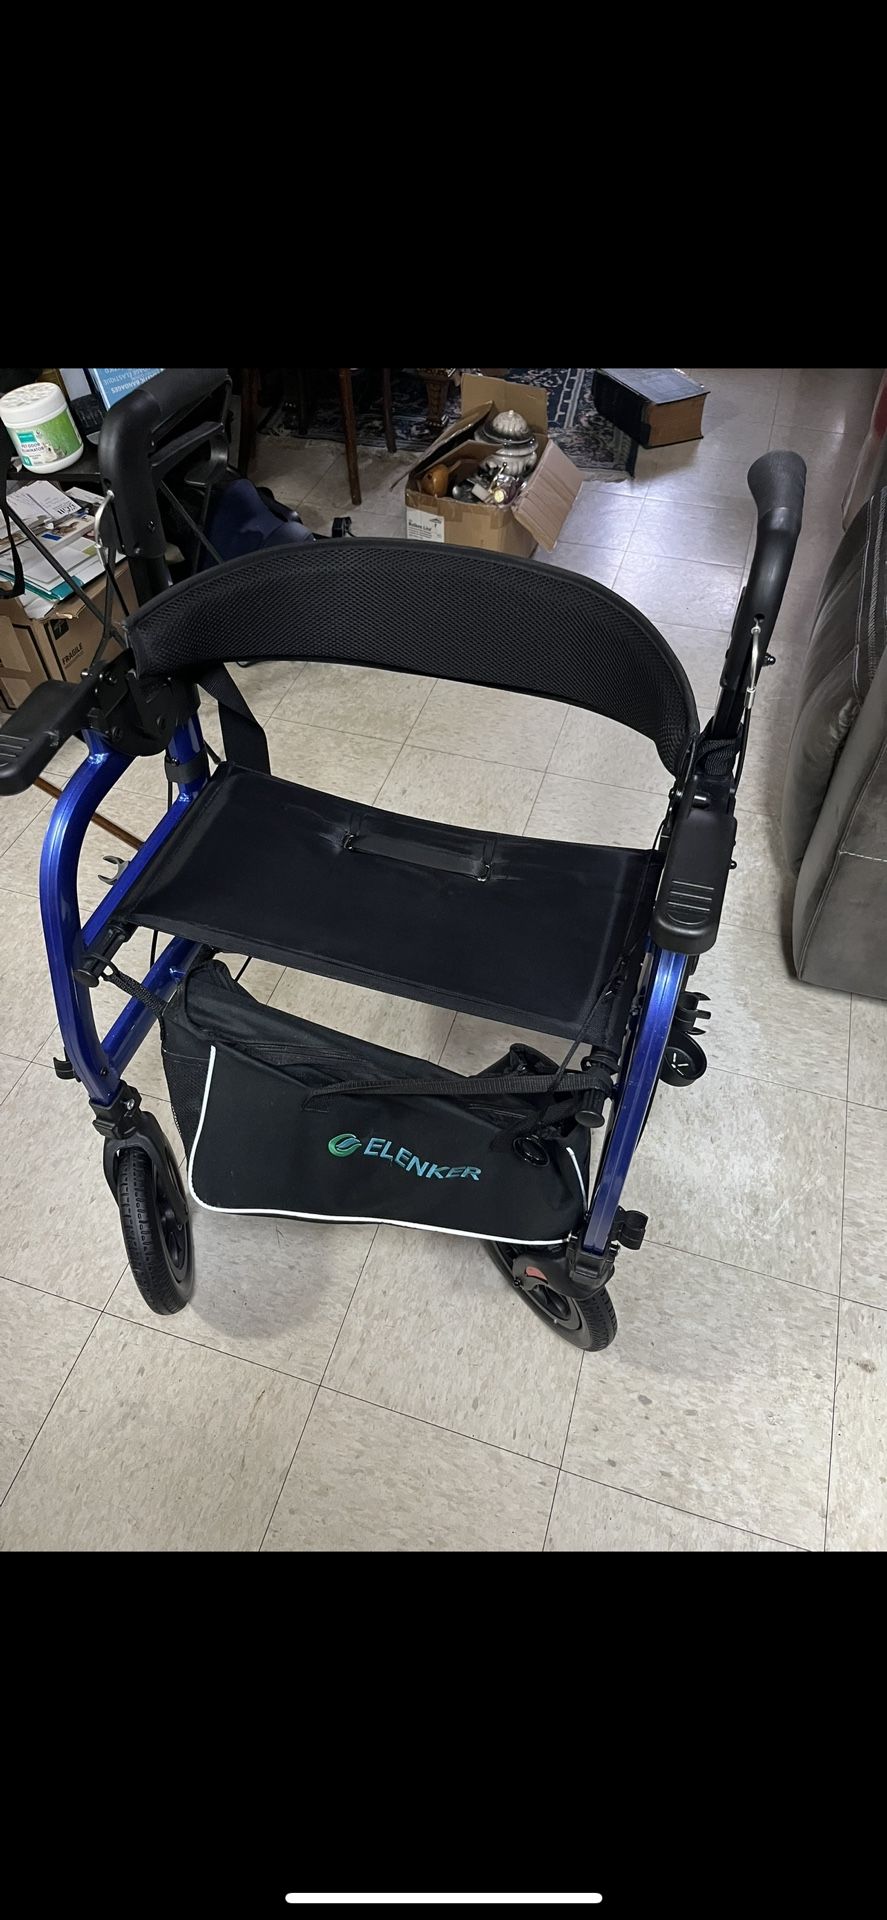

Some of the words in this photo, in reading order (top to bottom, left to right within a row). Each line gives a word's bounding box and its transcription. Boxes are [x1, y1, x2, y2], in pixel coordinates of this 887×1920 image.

[111, 379, 141, 394] BANDAGES
[62, 642, 83, 665] FRAGILE
[363, 1137, 482, 1181] ELENKER
